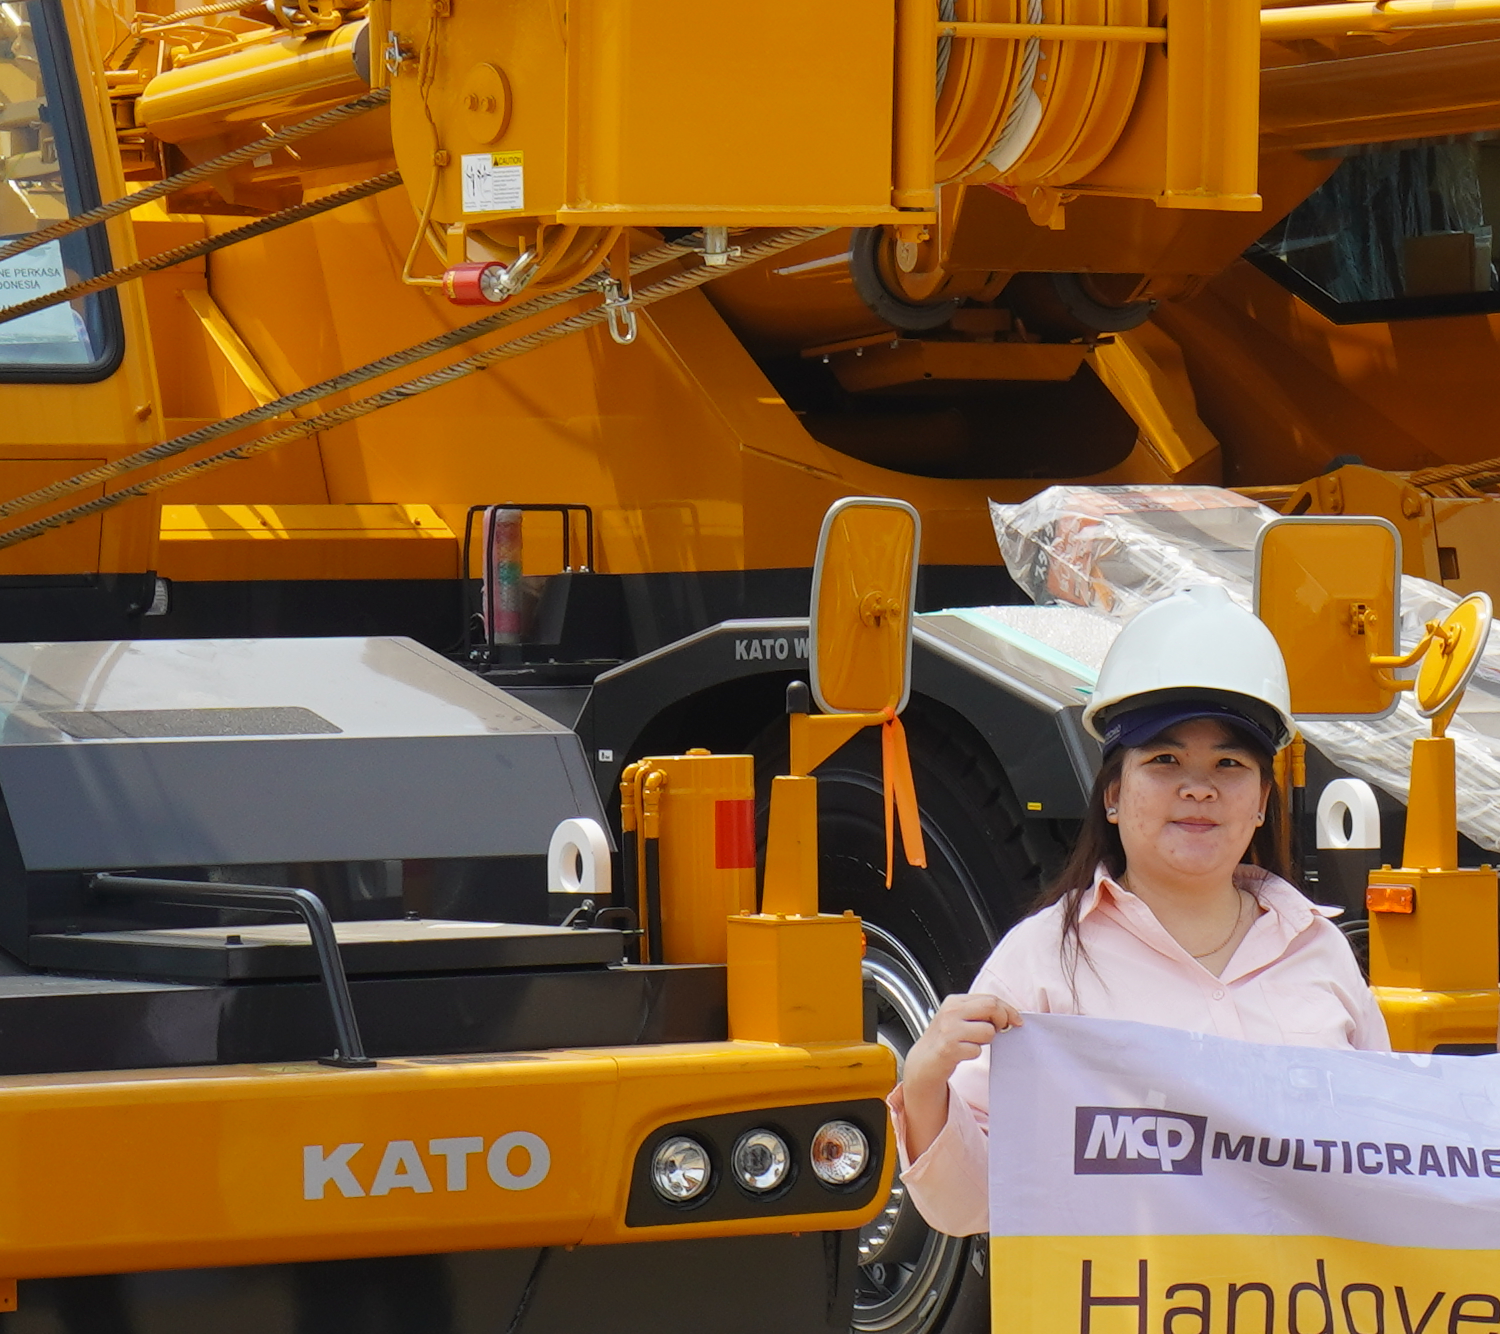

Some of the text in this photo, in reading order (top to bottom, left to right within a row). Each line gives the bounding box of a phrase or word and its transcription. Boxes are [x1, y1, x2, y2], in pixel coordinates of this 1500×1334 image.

[13, 268, 62, 278] PERKASA
[734, 637, 789, 661] KATO
[302, 1130, 552, 1201] KATO
